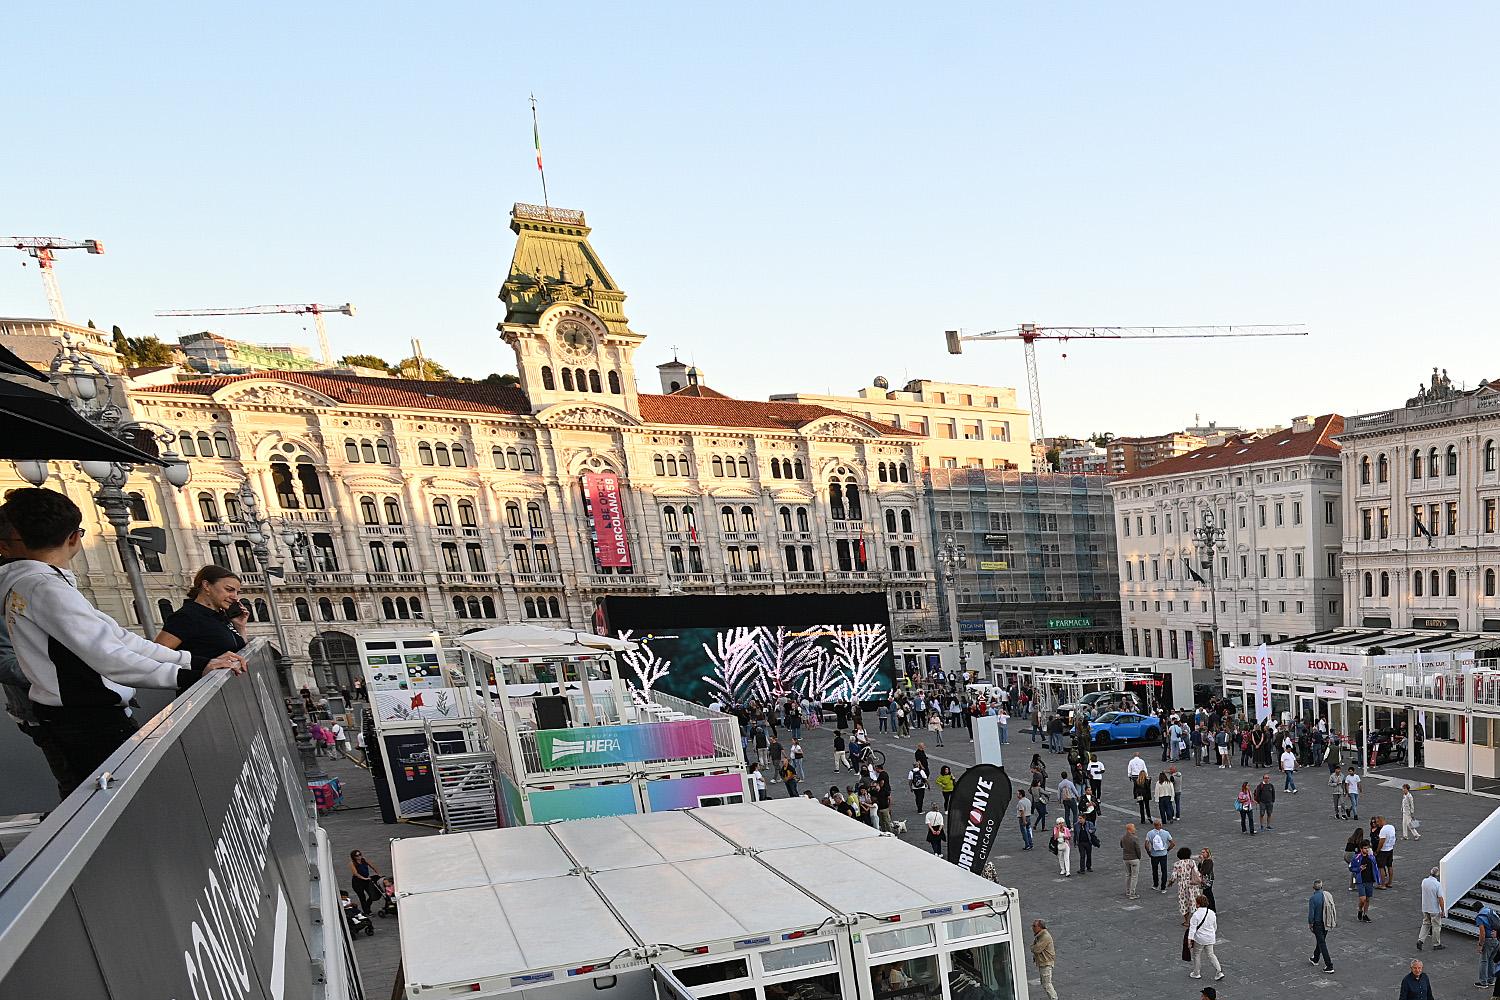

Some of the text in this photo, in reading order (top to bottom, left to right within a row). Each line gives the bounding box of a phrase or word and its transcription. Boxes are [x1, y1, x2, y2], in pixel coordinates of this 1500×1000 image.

[1238, 655, 1274, 667] HONA
[1307, 660, 1349, 672] HONDA
[1260, 656, 1269, 708] HONDA
[585, 738, 621, 753] HERA
[979, 819, 995, 860] CHICAGO
[214, 803, 261, 962] FRIULI
